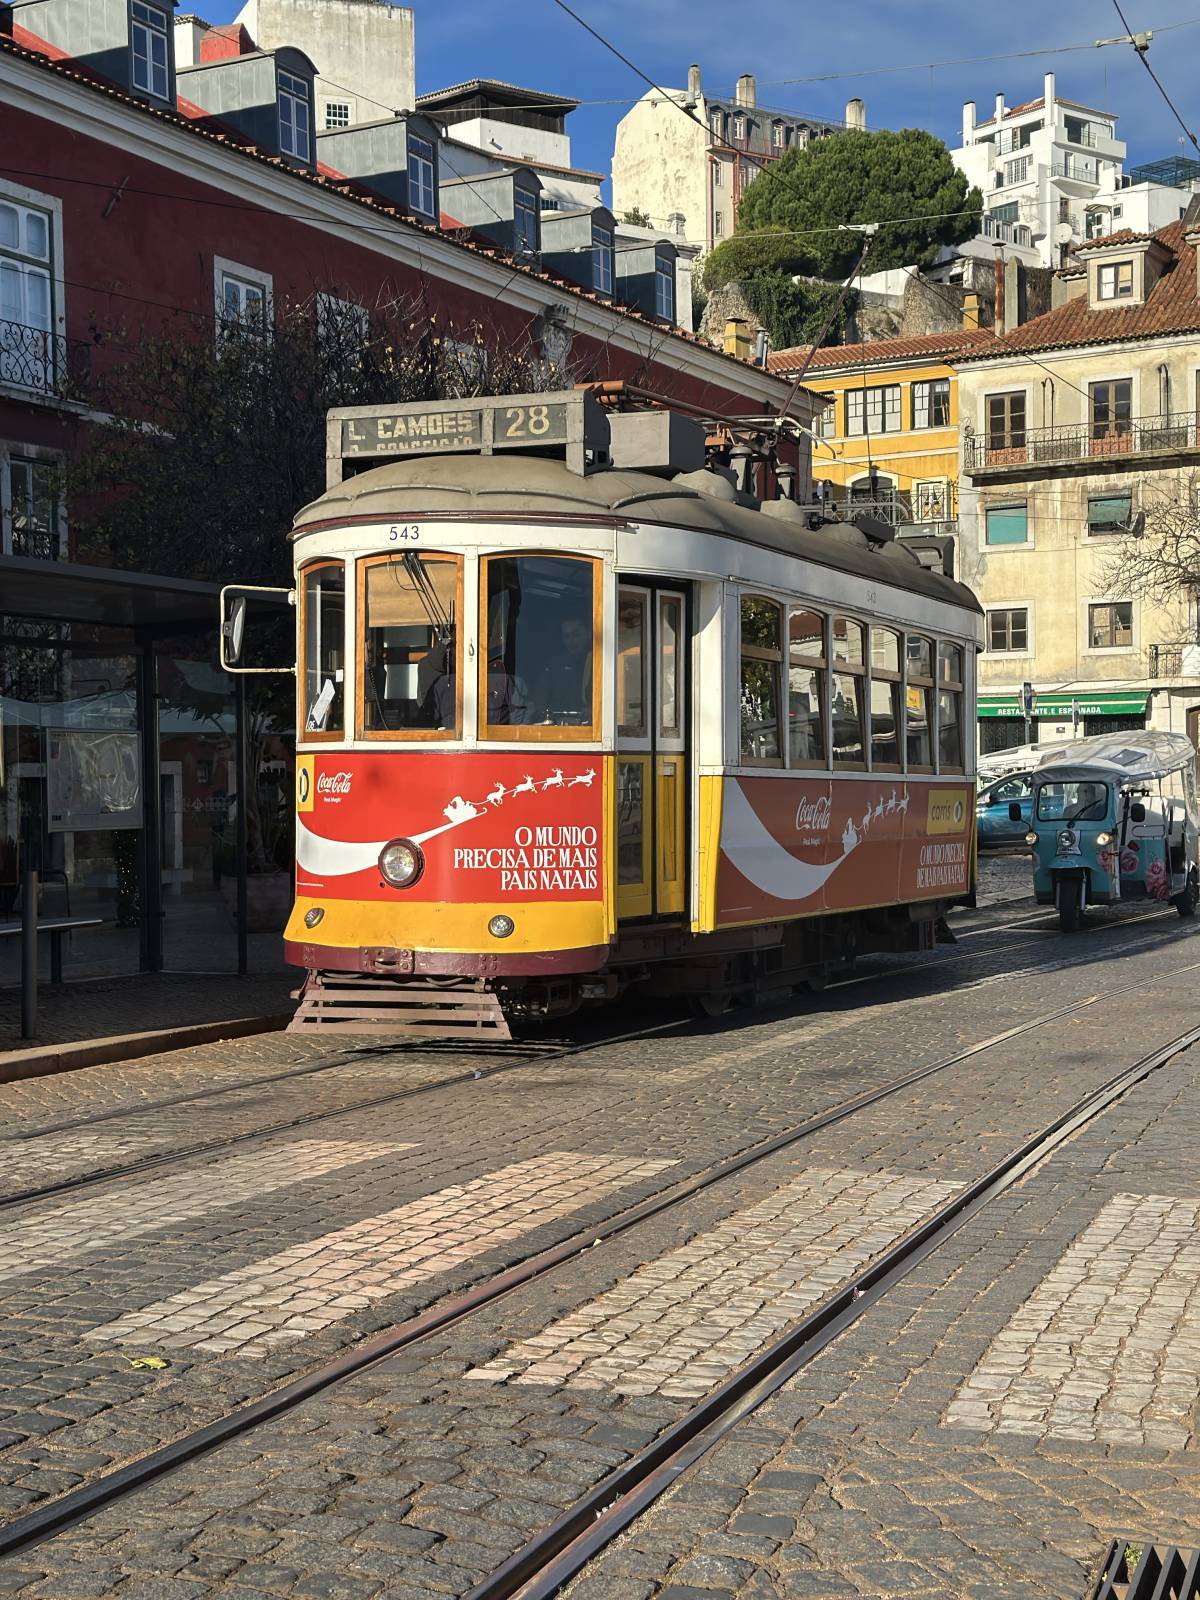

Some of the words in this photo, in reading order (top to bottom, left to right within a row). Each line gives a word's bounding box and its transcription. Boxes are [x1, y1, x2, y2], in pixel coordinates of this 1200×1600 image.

[348, 420, 366, 441] L.
[506, 406, 550, 437] 28
[389, 525, 420, 541] 543
[317, 772, 354, 793] Coca-Cola
[515, 826, 533, 847] O
[535, 826, 598, 847] MUNDO
[454, 848, 531, 869] PRECISA
[533, 848, 556, 868] DE
[559, 847, 598, 868] MAIS
[501, 870, 537, 890] PAIS
[540, 869, 598, 890] NATAIS
